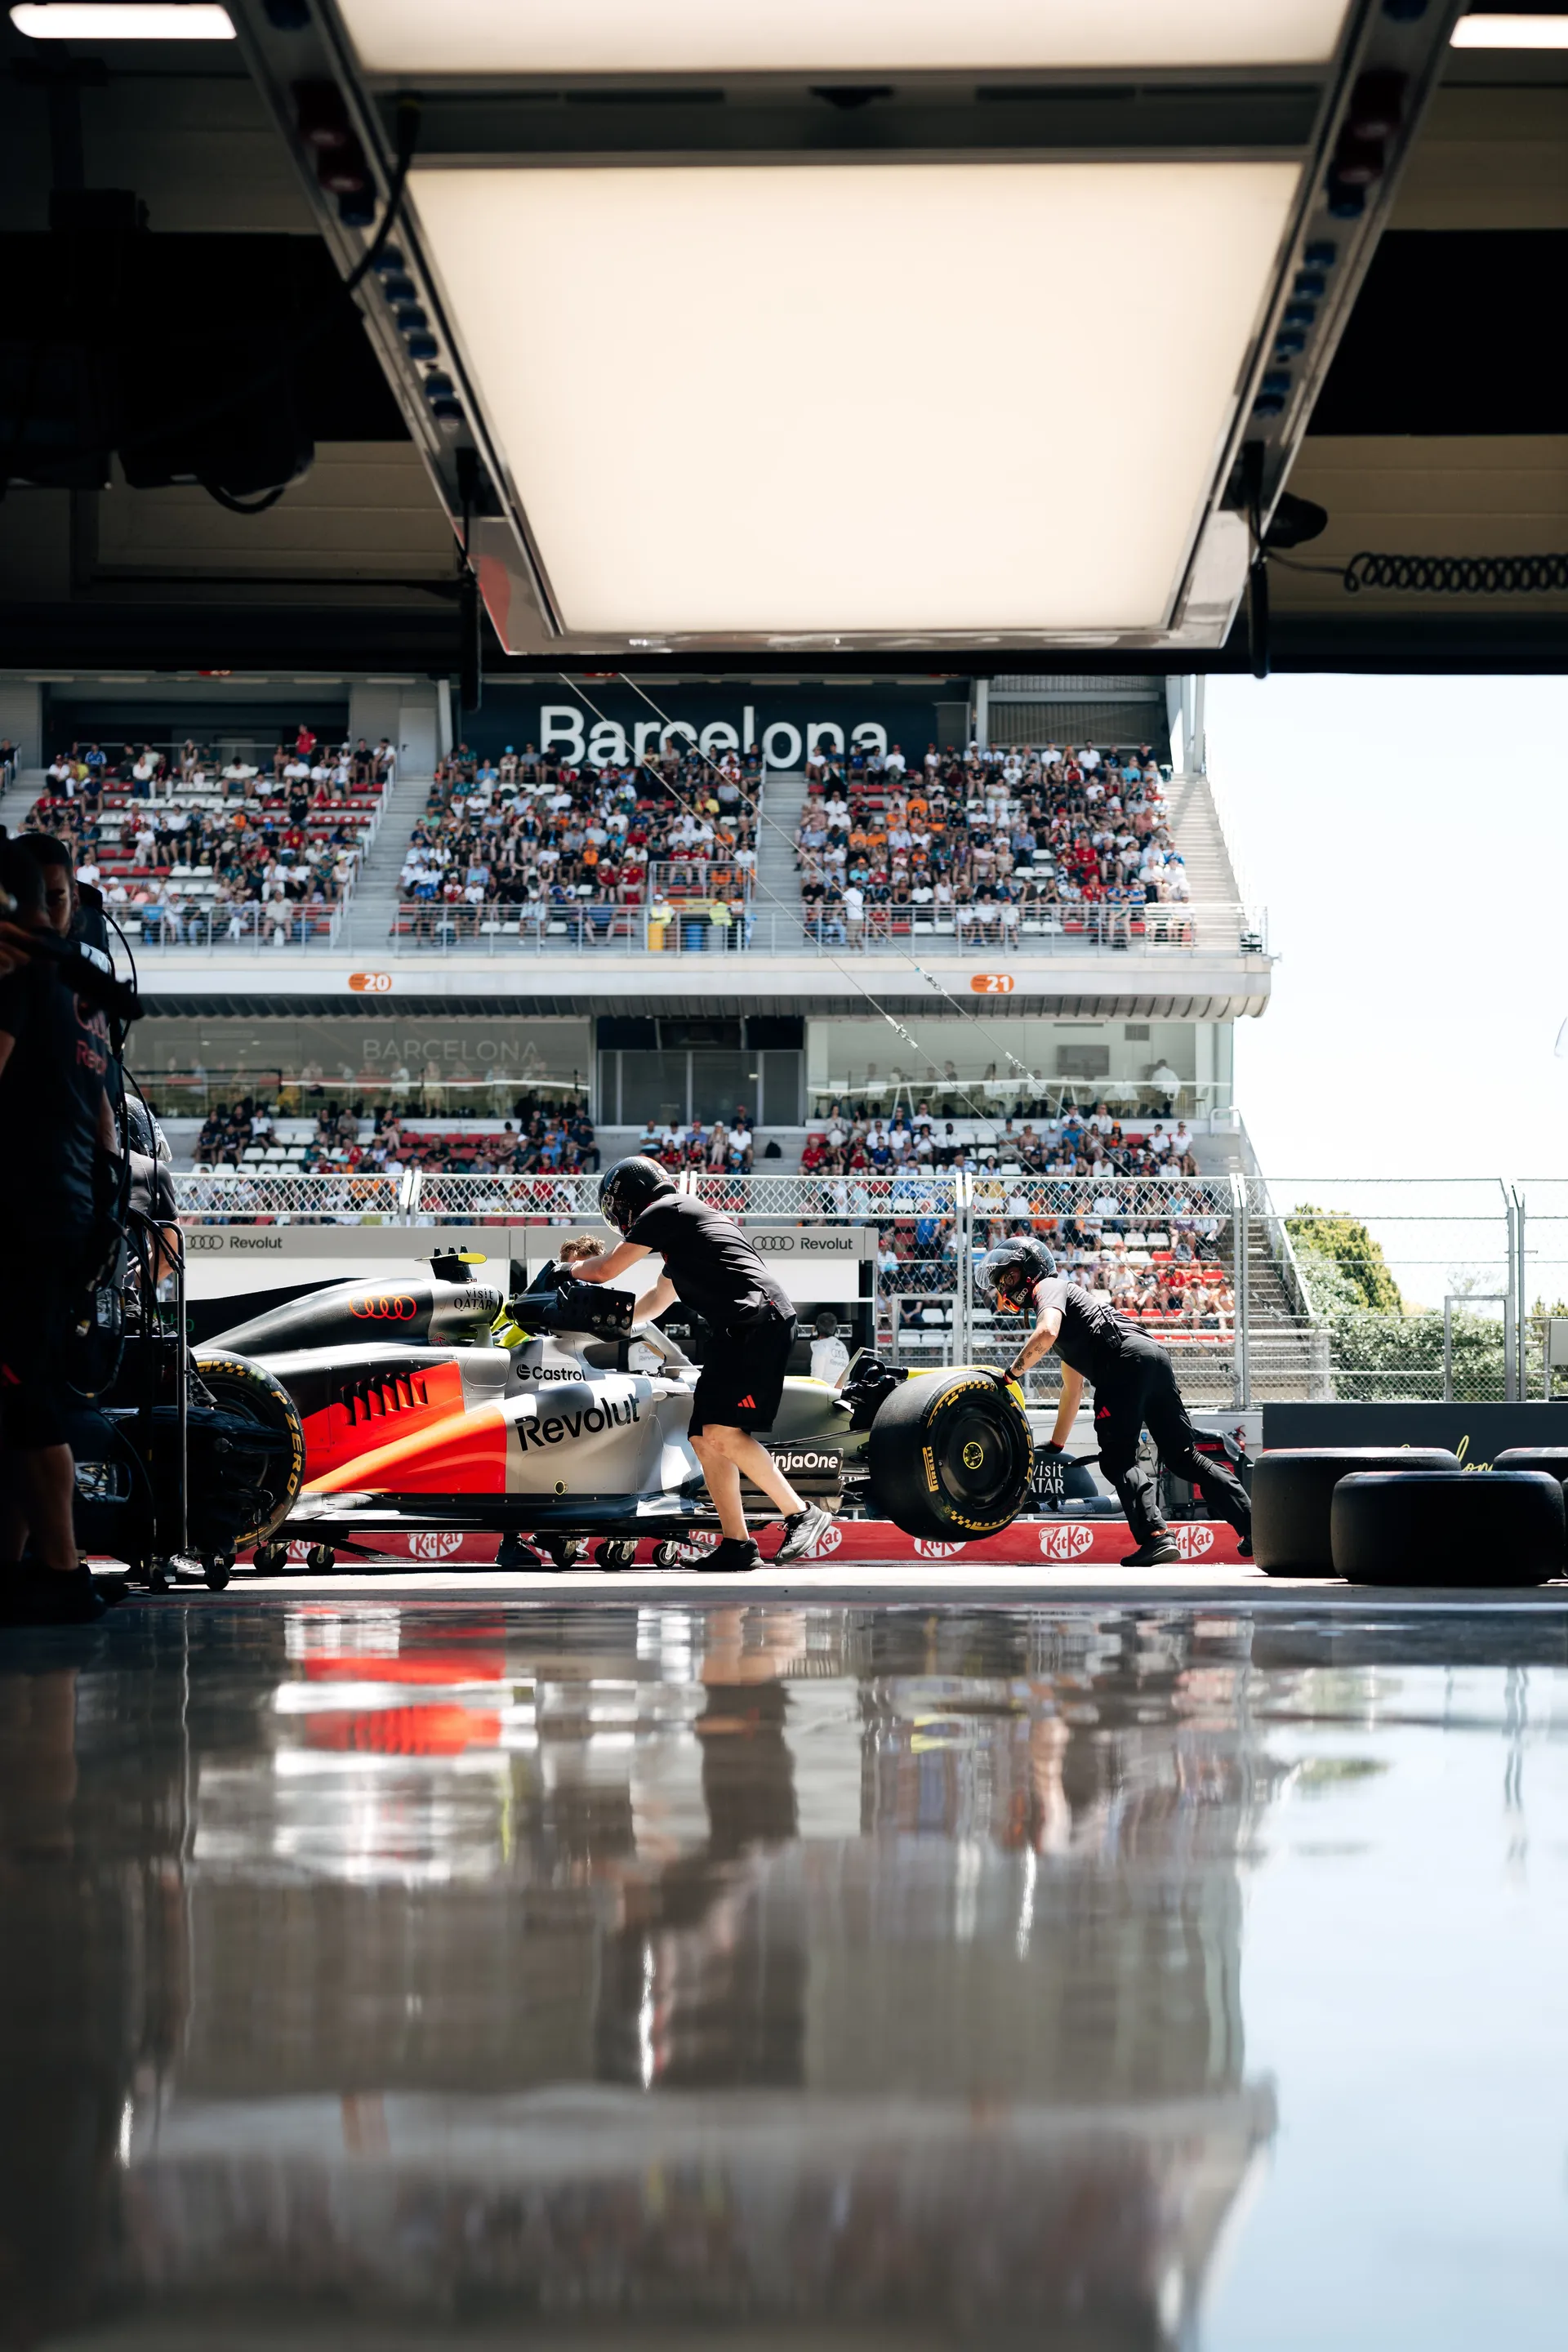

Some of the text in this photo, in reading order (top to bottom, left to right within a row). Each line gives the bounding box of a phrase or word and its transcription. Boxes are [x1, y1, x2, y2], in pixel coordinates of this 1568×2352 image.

[541, 706, 888, 768] Barcelona
[364, 974, 390, 991] 20
[986, 976, 1009, 991] 21
[363, 1039, 541, 1062] BARCELONA
[229, 1236, 283, 1249] Revolut
[800, 1237, 853, 1250] Revolut
[466, 1288, 493, 1300] visit
[454, 1298, 493, 1312] QATAR
[532, 1366, 586, 1381] Castrol
[514, 1393, 640, 1451] Revolut
[271, 1391, 303, 1496] P ZERO
[771, 1451, 838, 1472] injaOne
[922, 1446, 939, 1492] PIRELLI
[1030, 1478, 1065, 1494] ATAR
[416, 1534, 460, 1557] KitKat
[804, 1529, 839, 1557] Kat
[920, 1540, 956, 1557] Kit
[1046, 1526, 1090, 1557] KitKat
[1176, 1526, 1210, 1557] itKat
